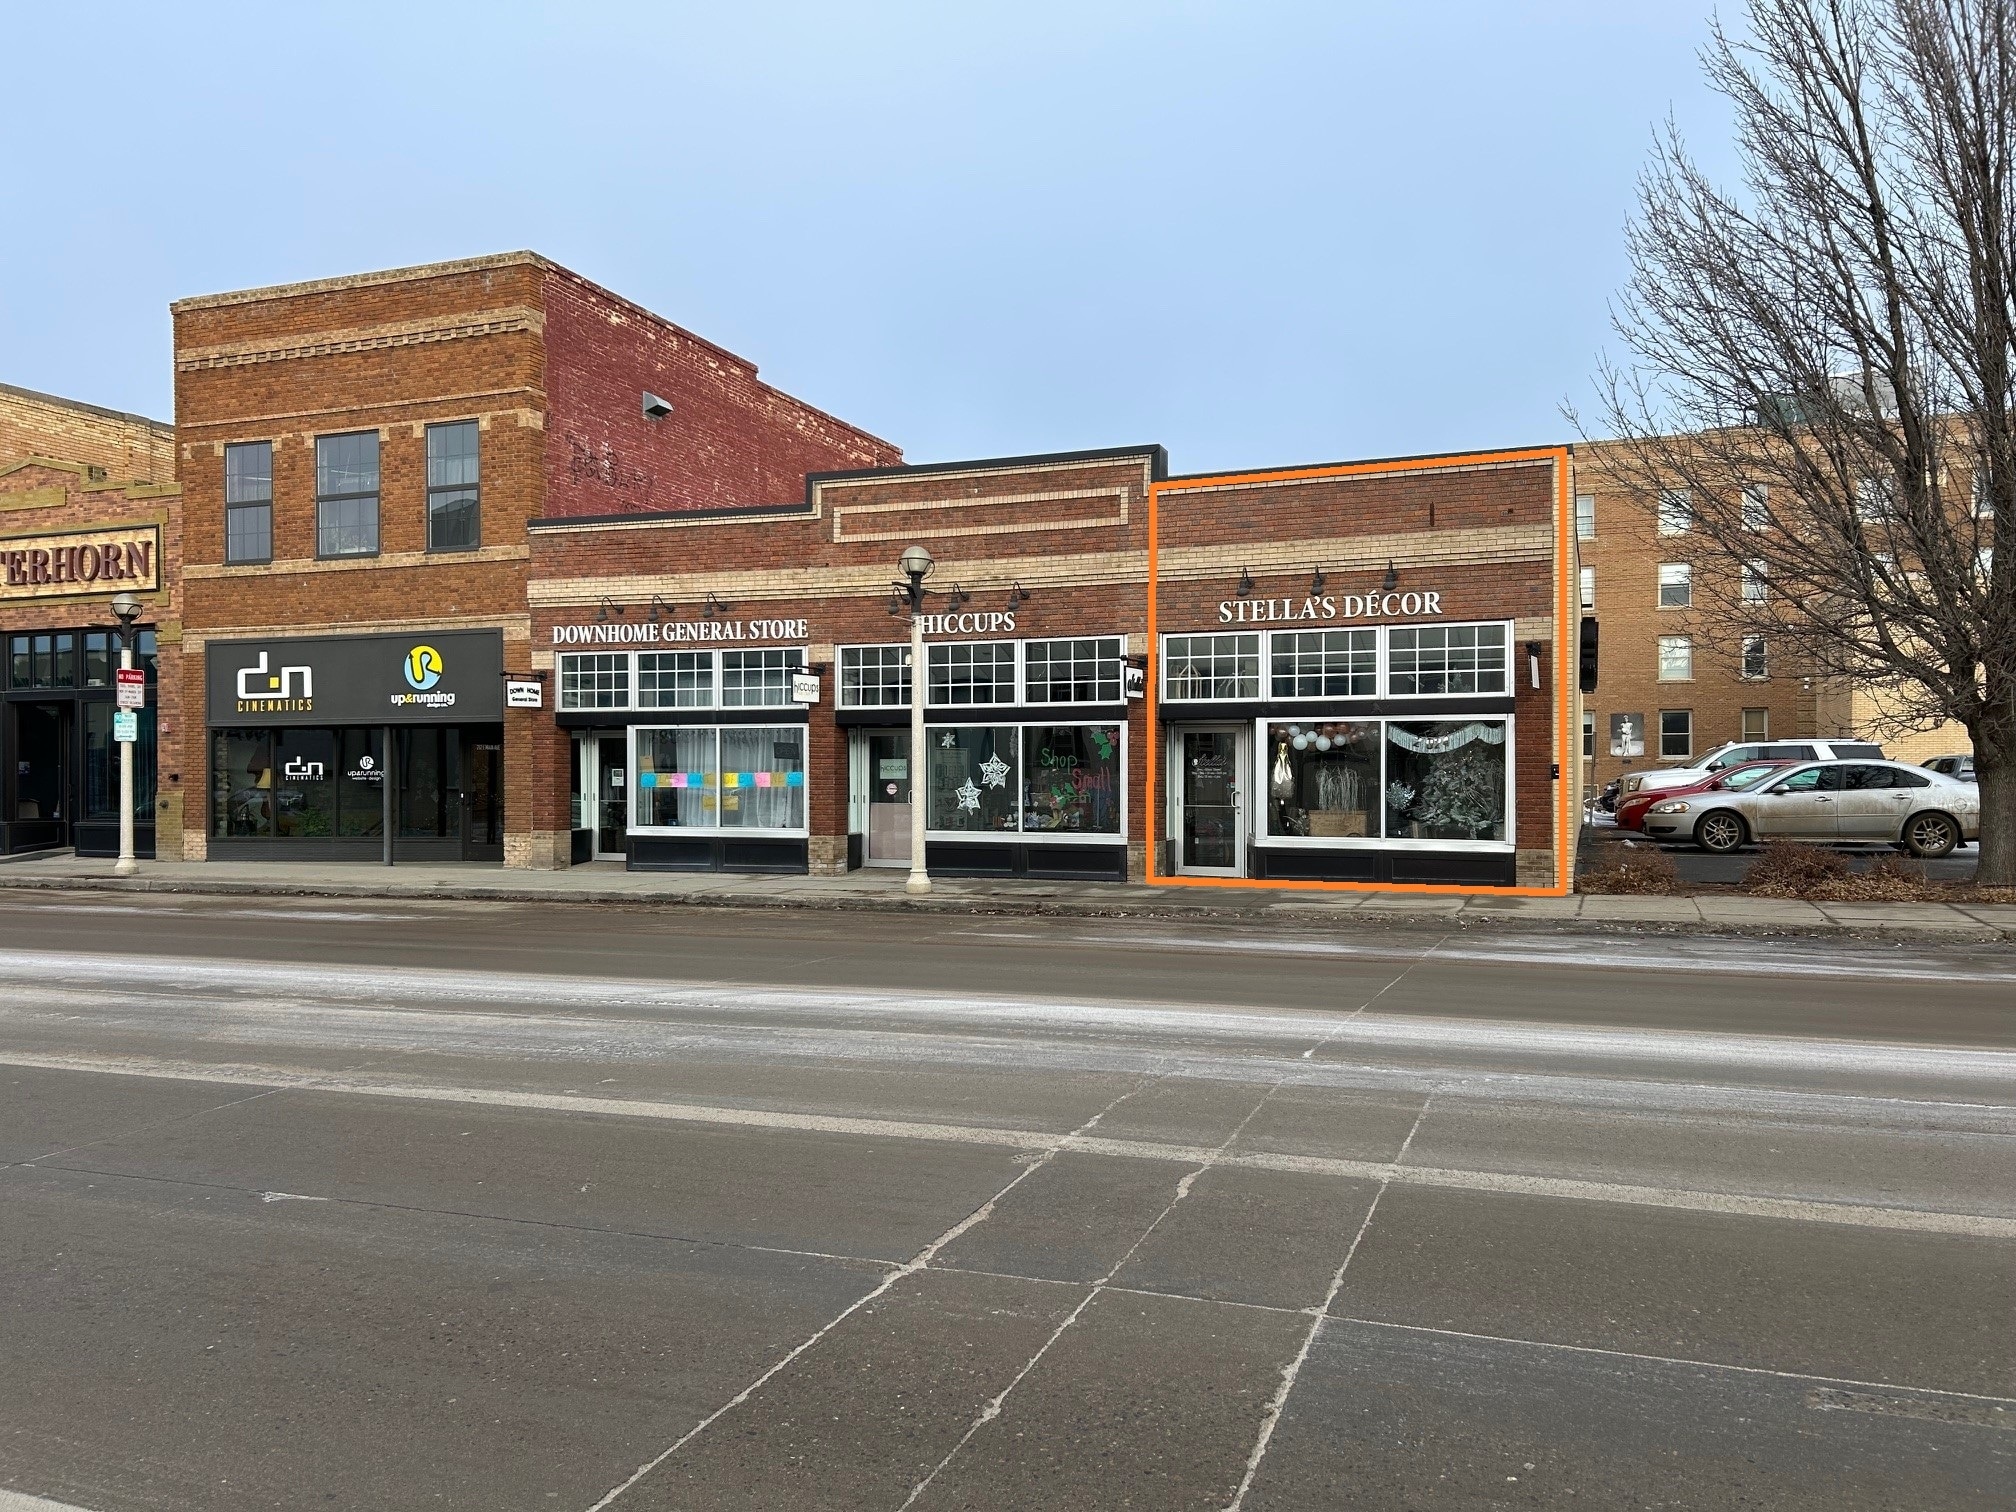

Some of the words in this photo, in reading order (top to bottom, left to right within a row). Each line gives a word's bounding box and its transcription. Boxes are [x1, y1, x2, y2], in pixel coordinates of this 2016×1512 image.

[0, 540, 152, 585] ERHORN
[1219, 596, 1336, 623] STELLA'S
[1342, 589, 1442, 617] DÉCOR
[552, 624, 660, 644] DOWNHOME
[662, 621, 747, 642] GENERAL
[749, 619, 809, 639] STORE
[921, 612, 1016, 634] HICCUPS
[390, 690, 456, 707] up&running
[509, 687, 525, 695] DOWN
[526, 687, 540, 696] HOME
[793, 680, 820, 695] hiccups
[237, 699, 313, 713] CINEMATICS
[1041, 747, 1078, 775] Shop
[1072, 766, 1112, 795] Small
